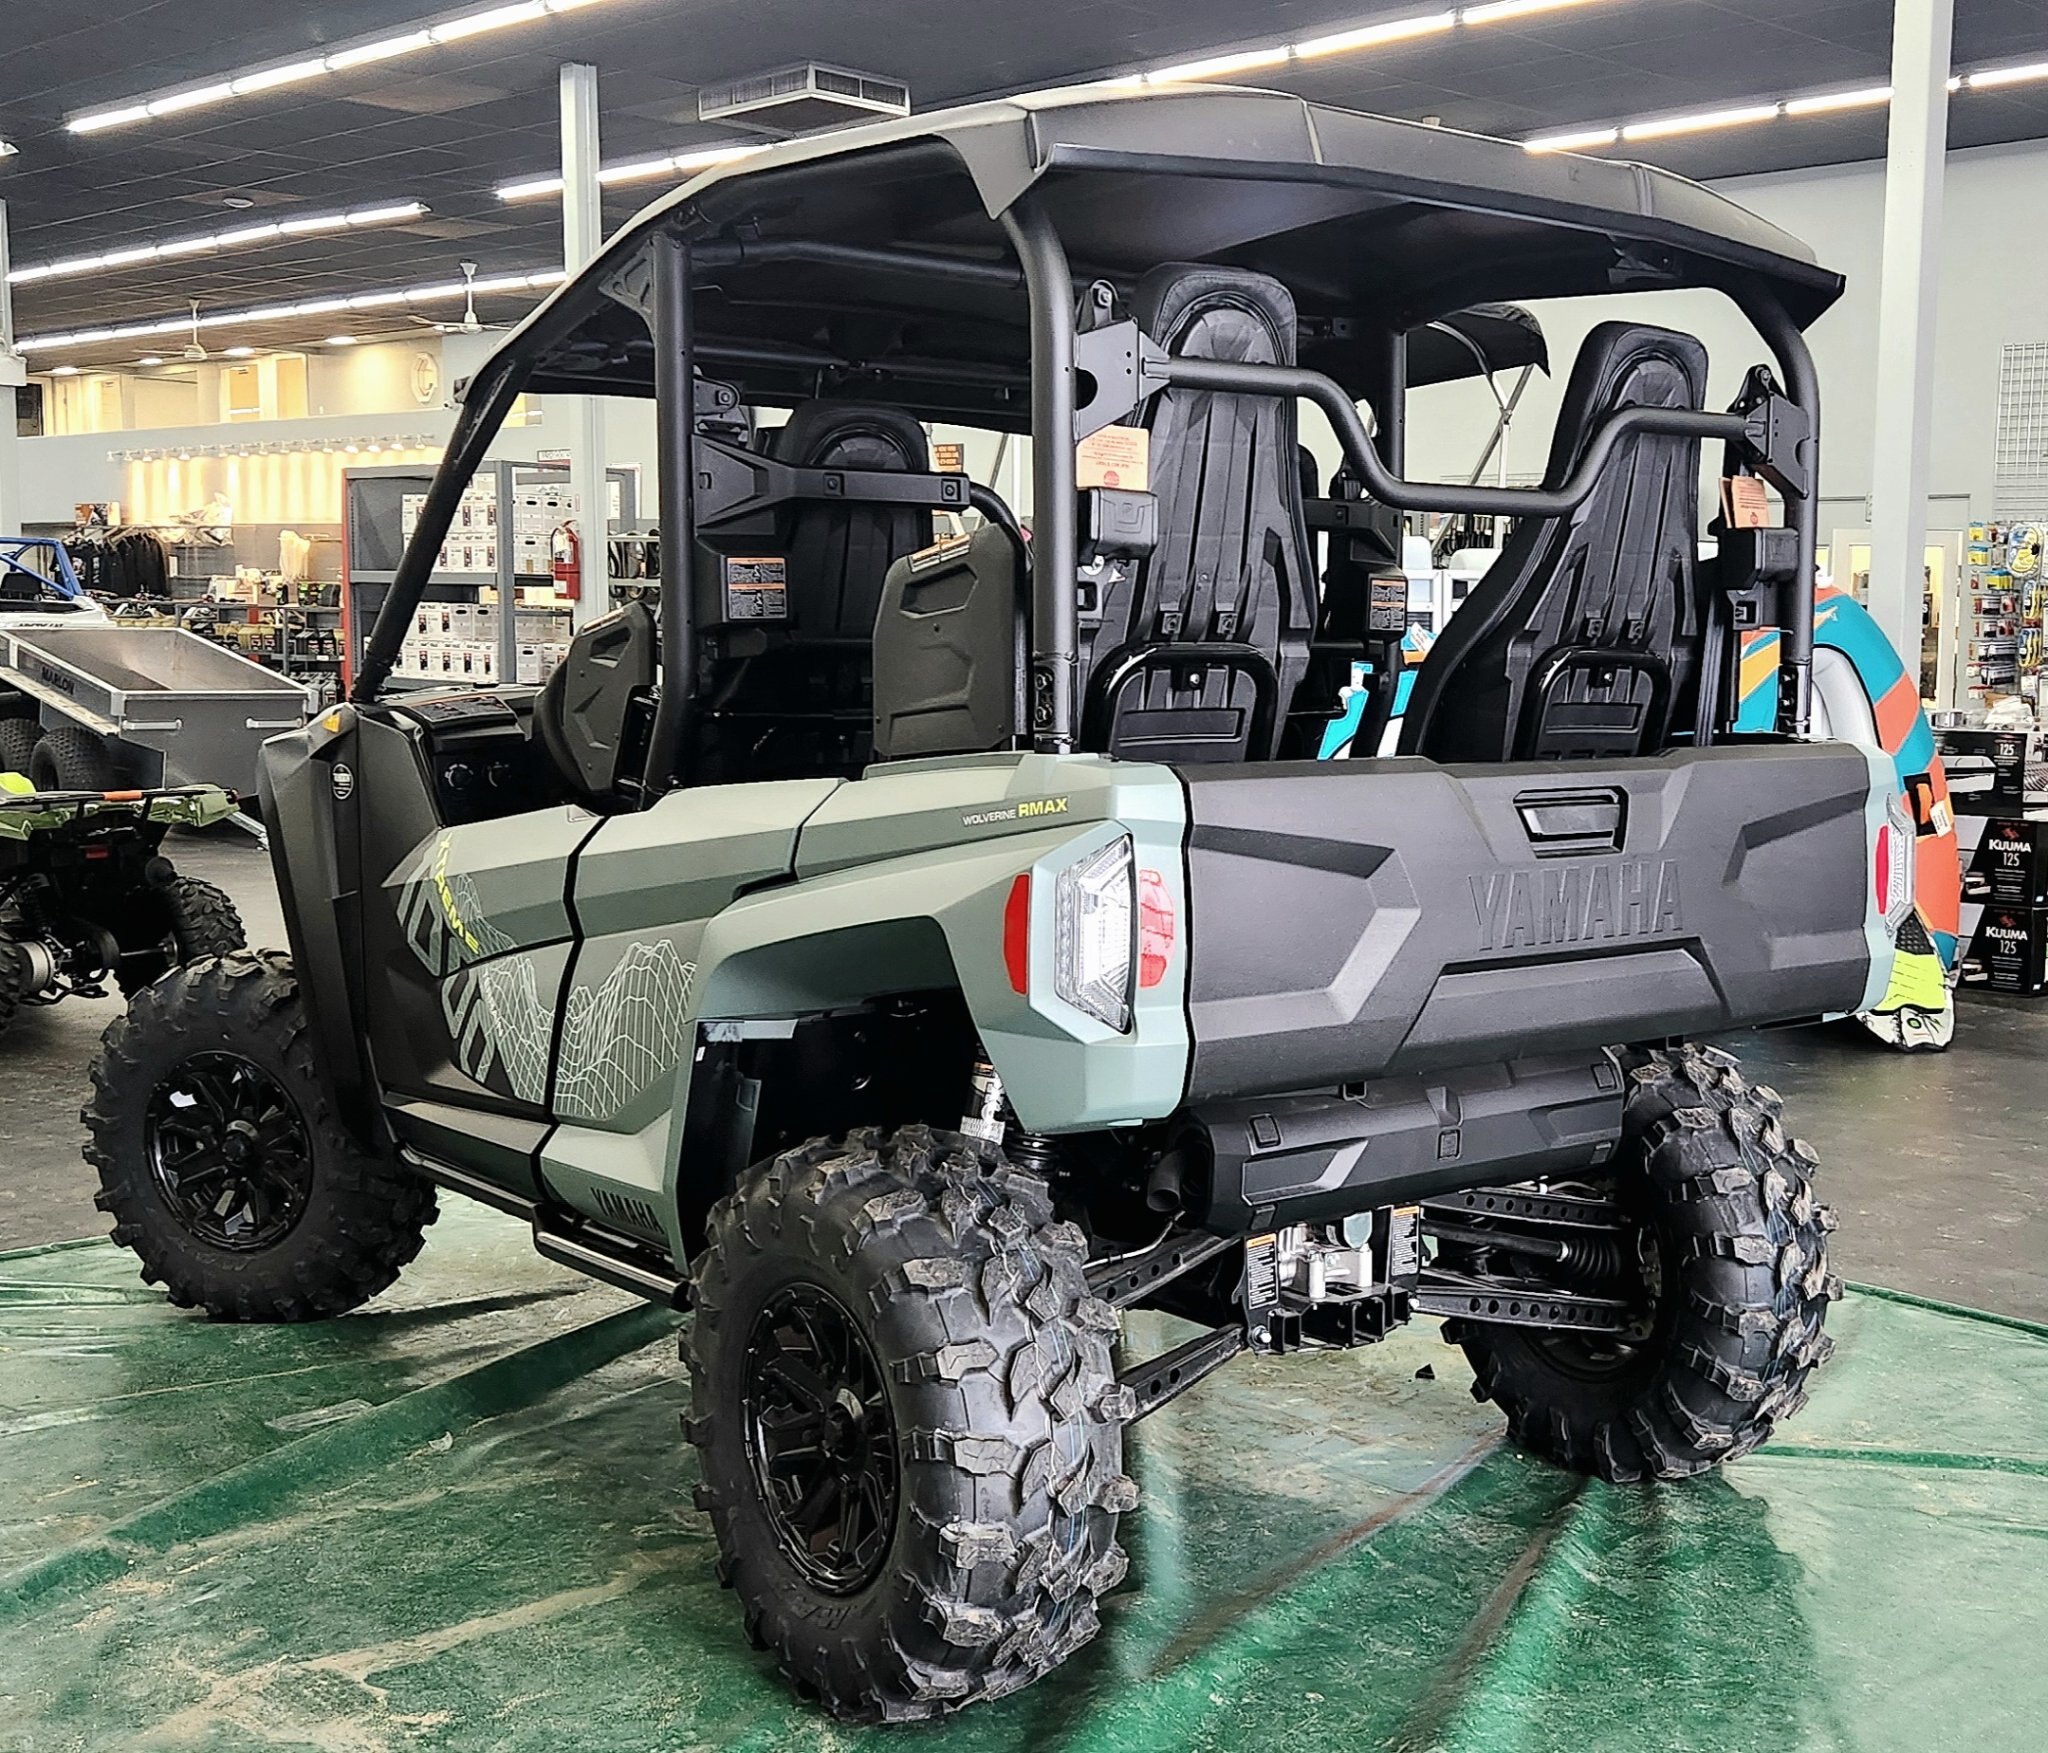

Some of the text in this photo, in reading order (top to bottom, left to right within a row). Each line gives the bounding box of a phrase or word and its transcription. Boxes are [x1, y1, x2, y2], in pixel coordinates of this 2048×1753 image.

[1999, 743, 2016, 756] 125
[962, 797, 1068, 826] WOLVERINE RMAX
[1988, 839, 2032, 853] KUUMA
[2002, 852, 2020, 867] 125
[434, 831, 481, 955] XTREME
[1468, 858, 1684, 951] YAMAHA
[1985, 926, 2029, 941] KUUMA
[1999, 940, 2017, 955] 125
[589, 1186, 665, 1235] YAMAHA
